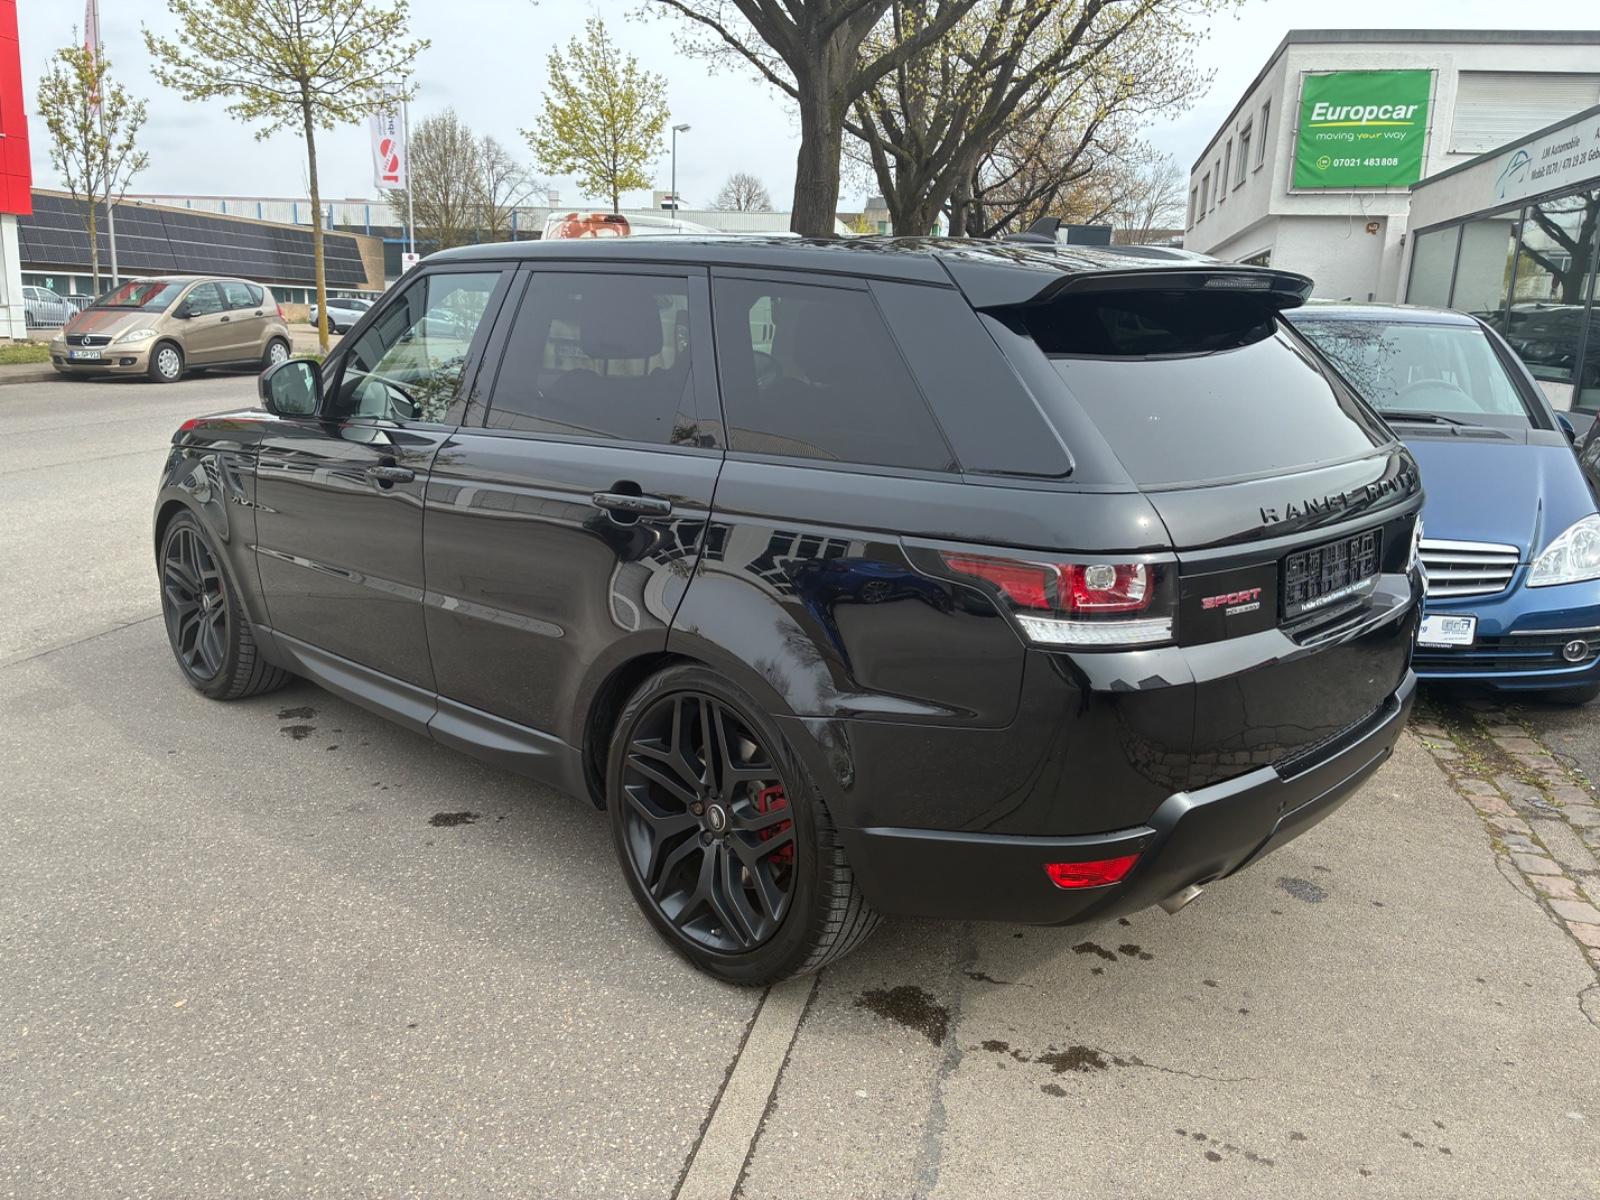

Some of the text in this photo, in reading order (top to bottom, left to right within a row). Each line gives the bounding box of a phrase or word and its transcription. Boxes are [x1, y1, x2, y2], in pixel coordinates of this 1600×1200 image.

[1311, 102, 1418, 125] Europcar
[1315, 130, 1408, 142] moving your way
[1551, 136, 1580, 156] Automobile
[1332, 157, 1360, 167] 07021
[1260, 491, 1353, 524] RANGE
[1201, 587, 1262, 609] SPORT
